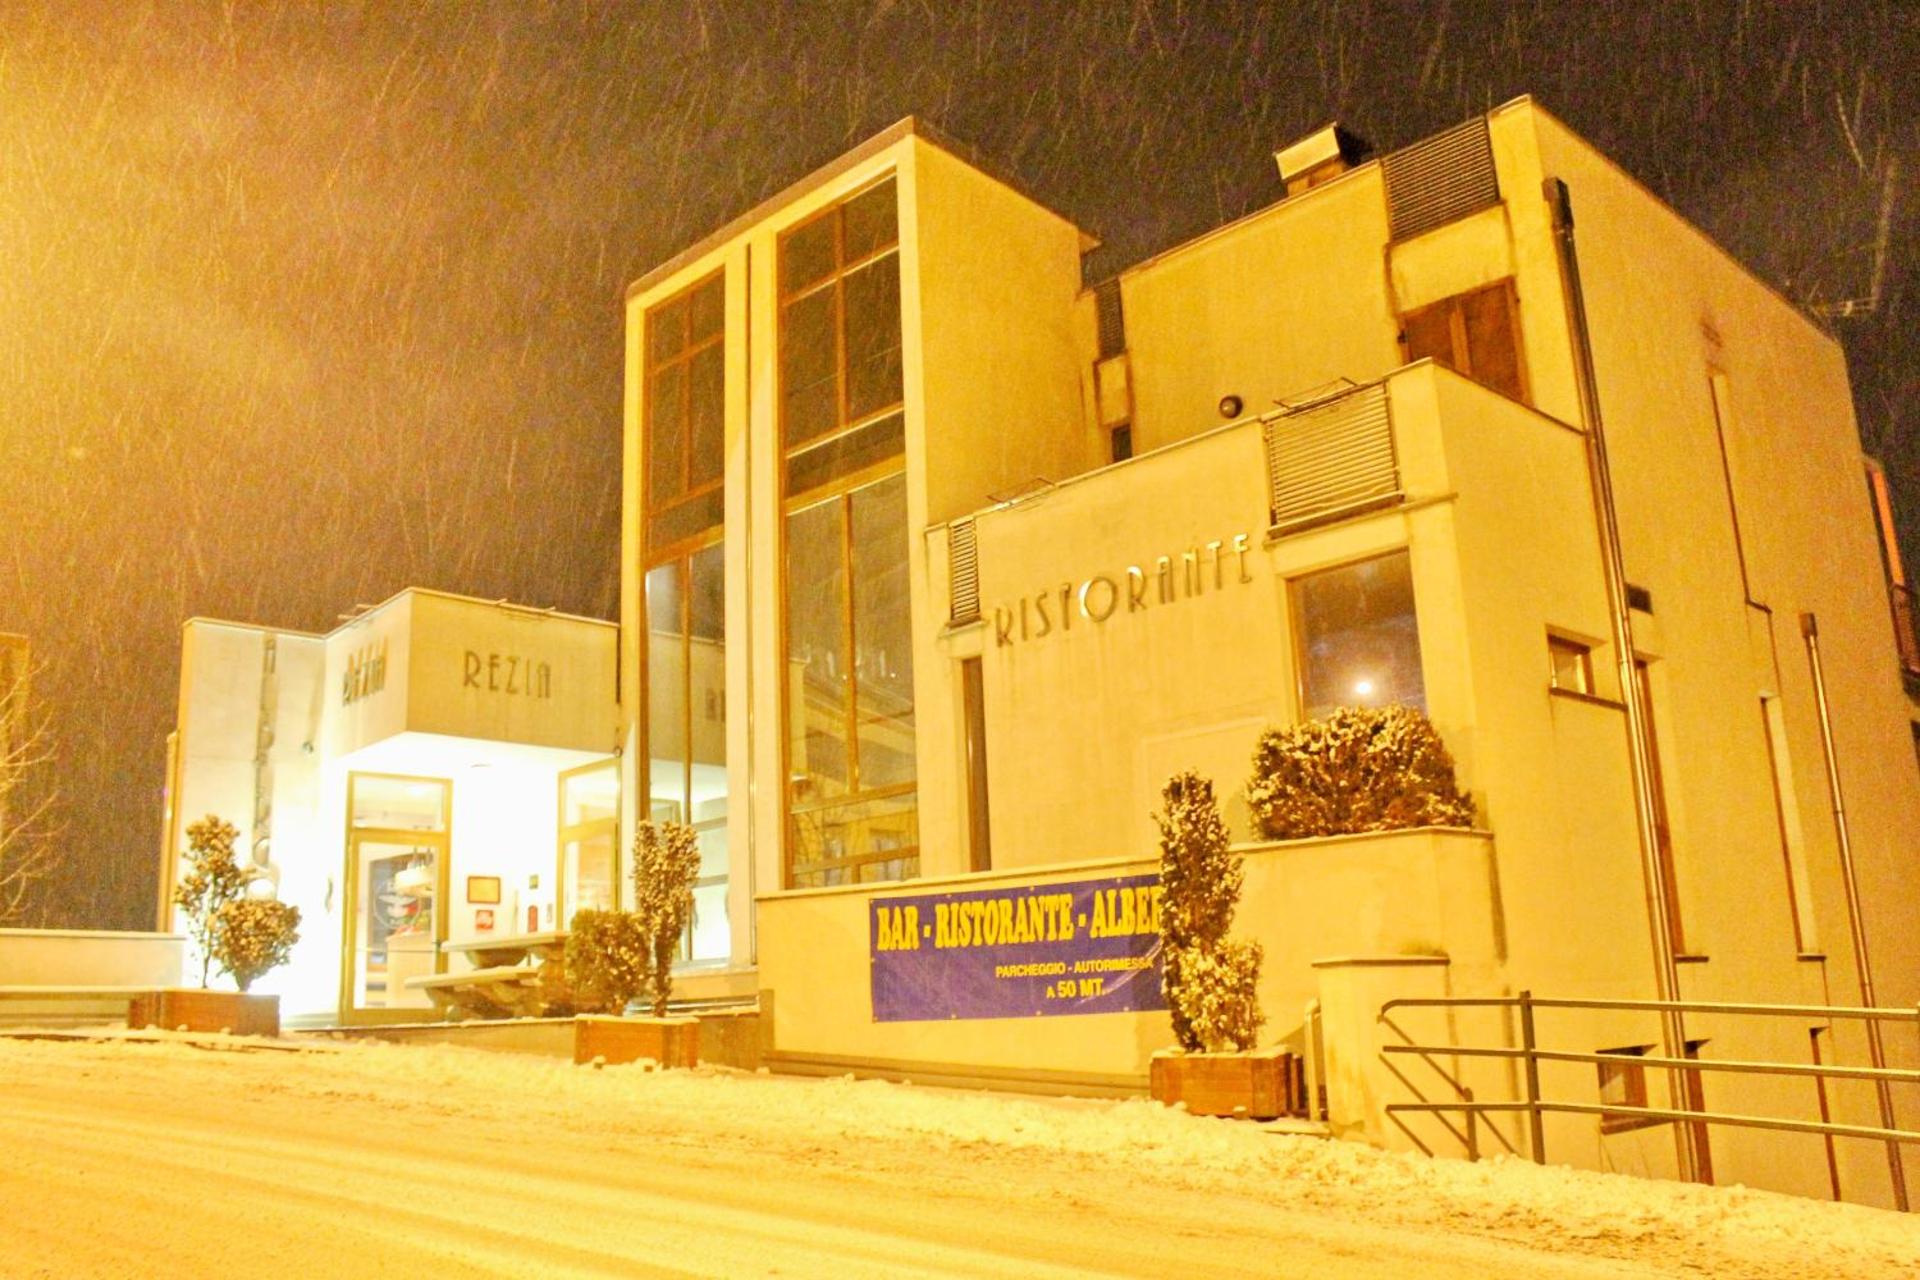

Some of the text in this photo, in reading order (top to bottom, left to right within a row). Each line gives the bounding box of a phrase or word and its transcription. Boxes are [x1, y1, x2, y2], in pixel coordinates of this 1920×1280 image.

[994, 532, 1252, 648] RISTORANTE
[463, 650, 551, 698] REZIA
[877, 905, 919, 951] BAR
[935, 892, 1075, 949] RISTORANTE
[995, 961, 1066, 978] PARCHEGGIO
[1074, 957, 1154, 973] AUTORIMESSA
[1046, 985, 1056, 999] A
[1057, 980, 1077, 998] 50
